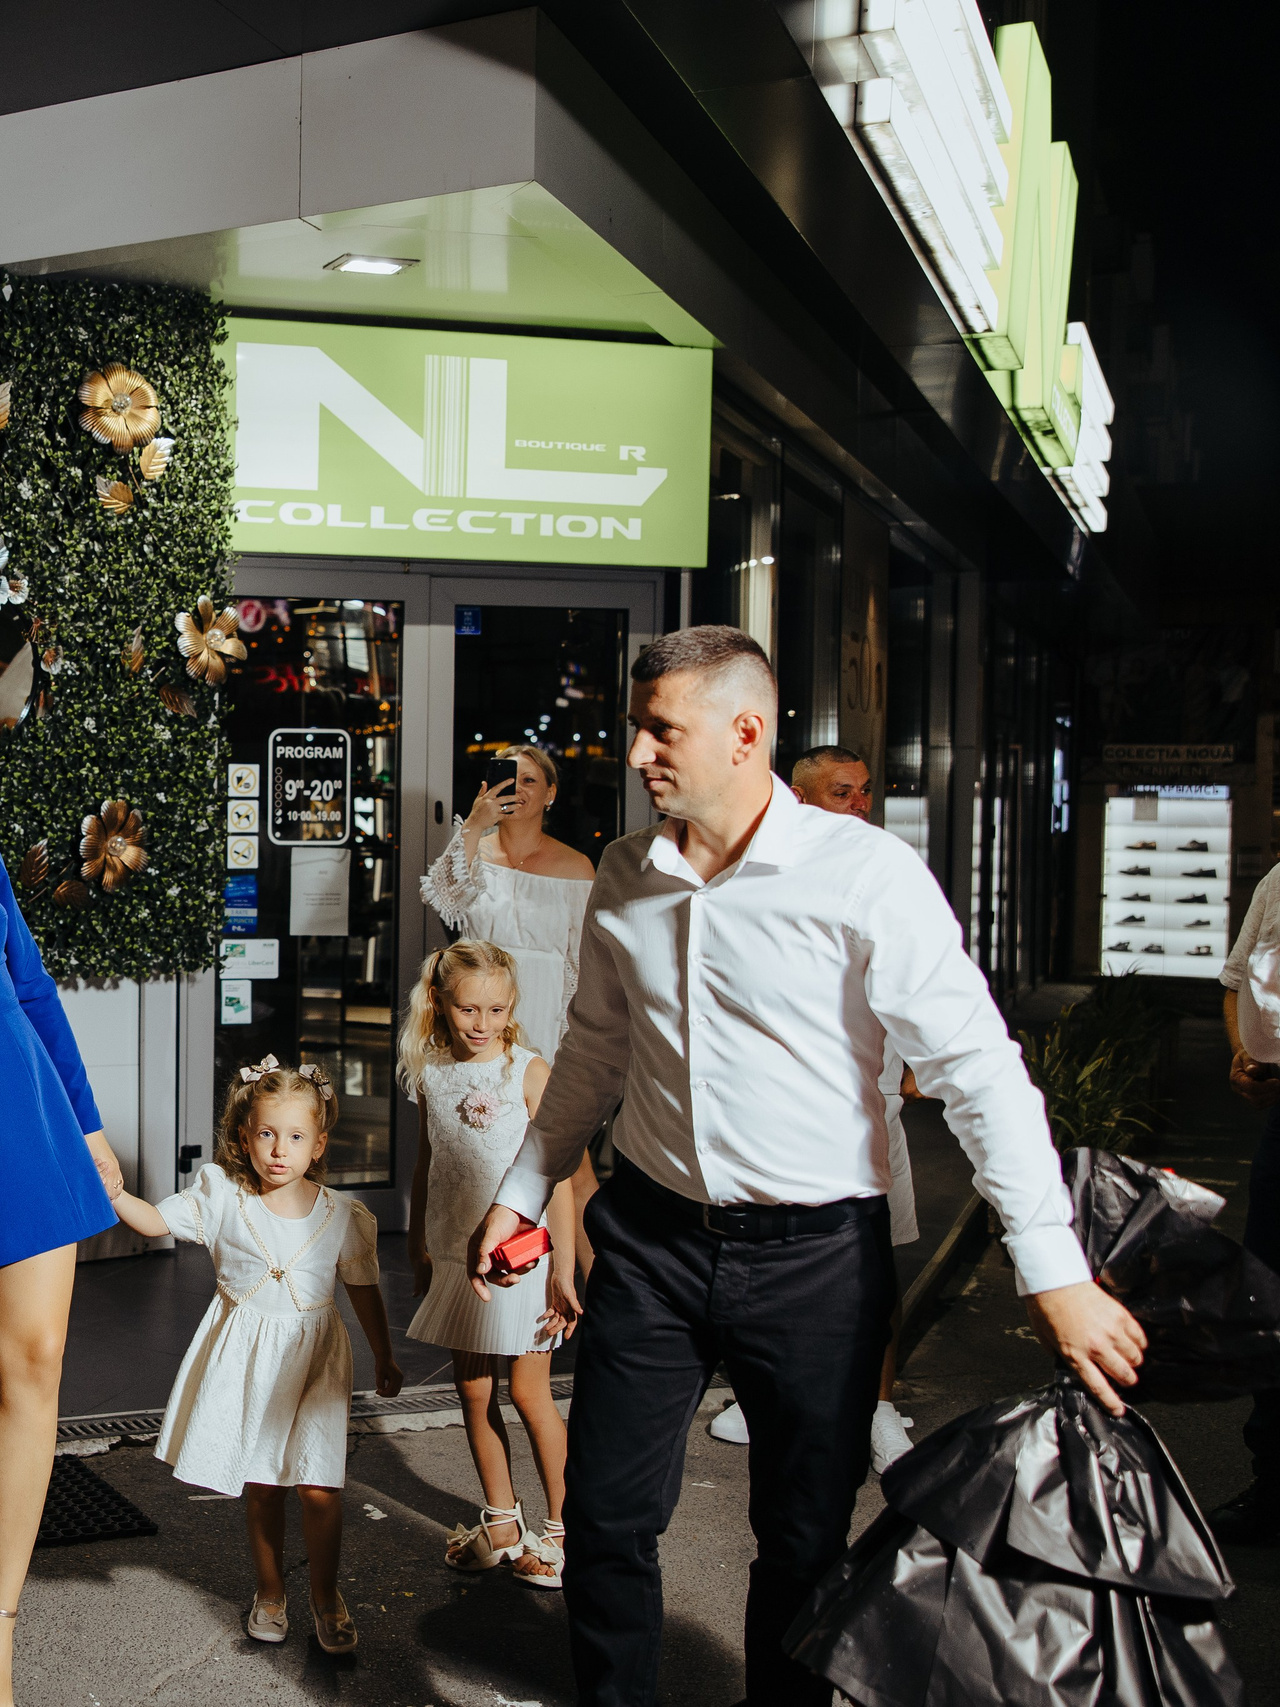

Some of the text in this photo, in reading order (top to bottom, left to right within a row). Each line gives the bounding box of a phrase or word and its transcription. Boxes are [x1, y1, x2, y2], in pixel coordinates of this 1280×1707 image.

[236, 341, 668, 506] NL
[514, 438, 646, 461] BOUTIQUE R
[236, 499, 642, 541] COLLECTION
[276, 746, 343, 759] PROGRAM
